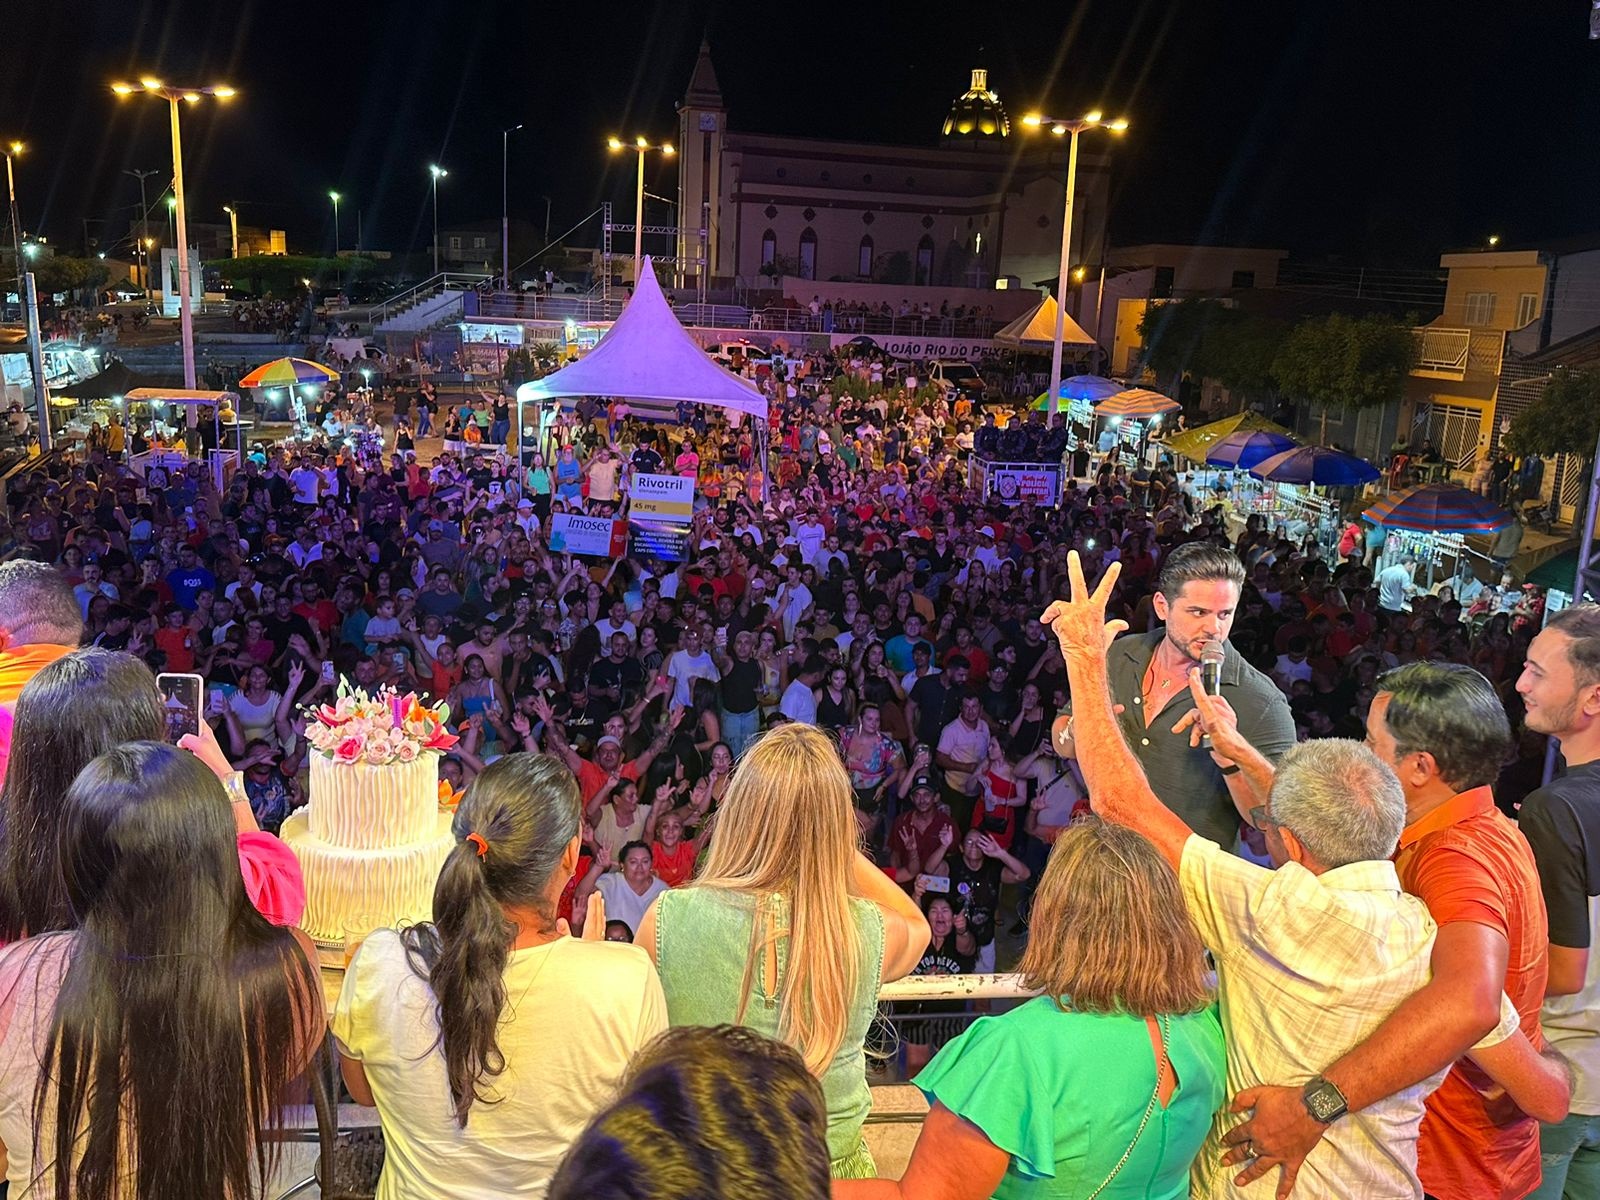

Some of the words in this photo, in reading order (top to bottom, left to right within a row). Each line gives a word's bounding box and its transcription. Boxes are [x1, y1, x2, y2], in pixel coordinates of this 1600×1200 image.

[884, 341, 921, 356] LOJÃO
[925, 343, 947, 355] RIO
[950, 345, 967, 356] DO
[638, 477, 683, 490] Rivotril
[633, 502, 643, 510] 45
[644, 504, 657, 512] mg
[567, 516, 610, 533] Imosec
[921, 955, 935, 968] YOU
[936, 956, 960, 974] NEVER
